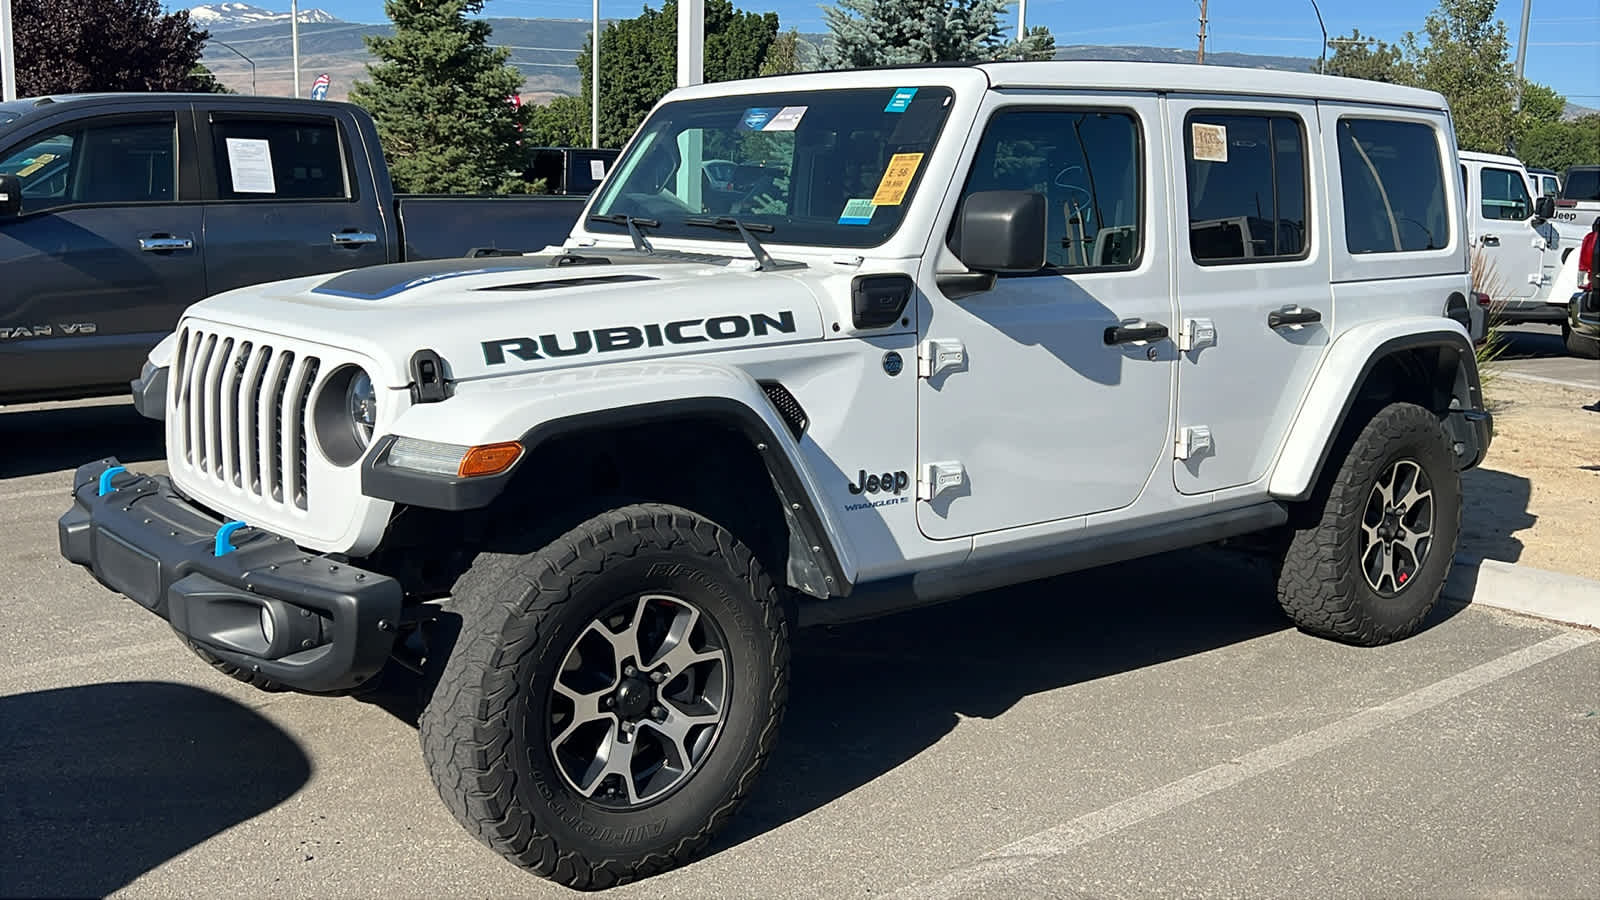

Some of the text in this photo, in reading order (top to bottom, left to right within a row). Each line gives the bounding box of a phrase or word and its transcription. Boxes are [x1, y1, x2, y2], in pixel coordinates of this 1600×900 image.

[1553, 211, 1577, 221] Jeep
[481, 310, 797, 366] RUBICON
[848, 469, 909, 495] Jeep
[844, 498, 899, 511] WRANGLER
